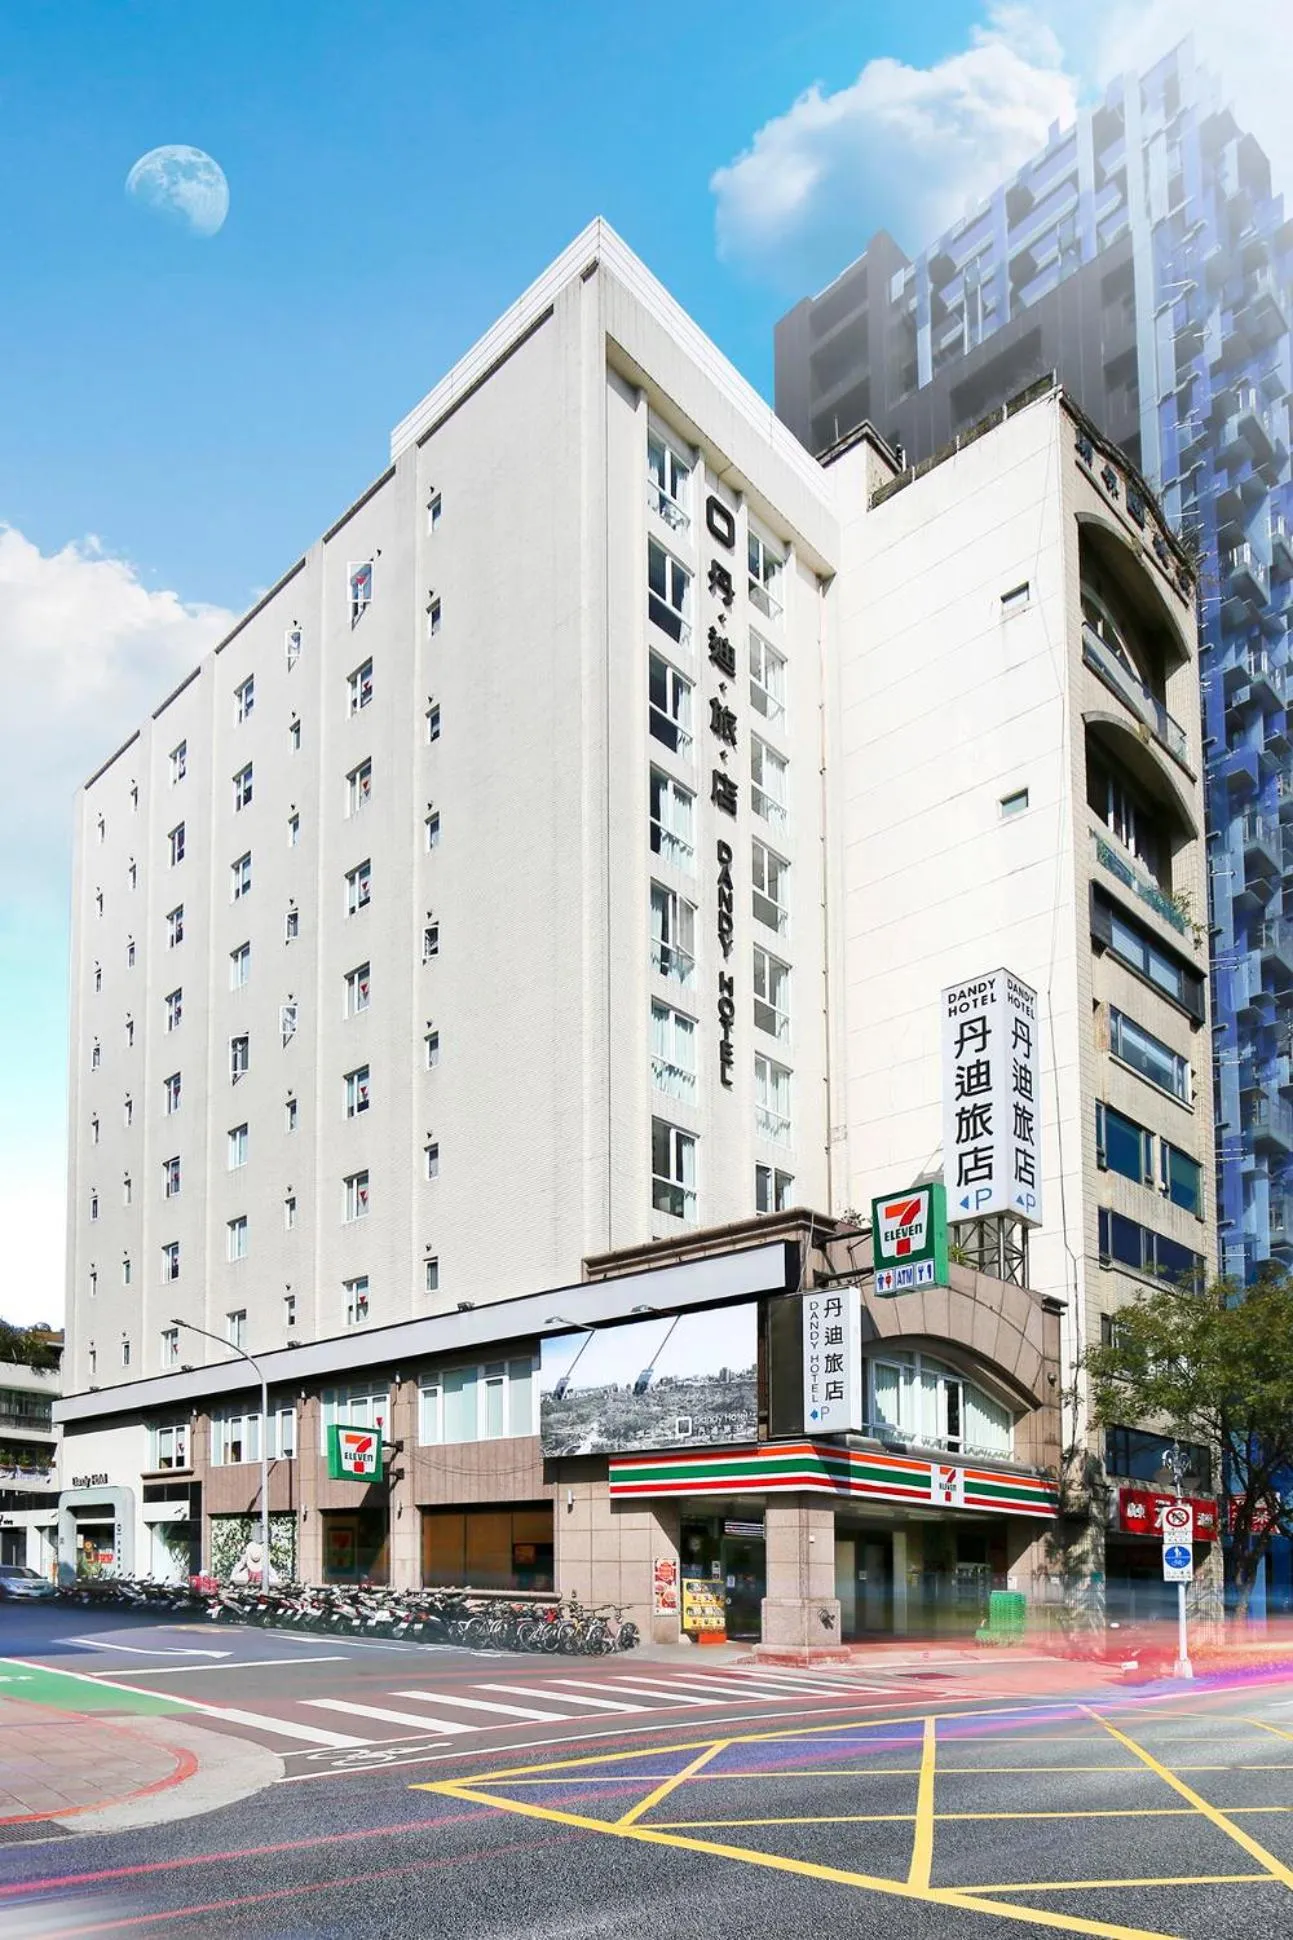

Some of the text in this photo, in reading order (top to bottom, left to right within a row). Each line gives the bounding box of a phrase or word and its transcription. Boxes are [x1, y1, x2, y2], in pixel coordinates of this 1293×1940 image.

[717, 839, 735, 1086] DANDY HOTEL
[948, 978, 996, 1005] DANDY
[948, 992, 997, 1018] HOTEL
[1007, 978, 1035, 1006] DANDY
[1007, 992, 1035, 1020] HOTEL
[954, 1015, 994, 1187] 丹迪旅店
[1011, 1016, 1035, 1189] 丹迪旅店
[976, 1188, 993, 1210] P
[1026, 1193, 1036, 1213] P
[896, 1267, 913, 1287] ATM
[809, 1301, 821, 1403] DANDY HOTEL
[823, 1297, 844, 1401] 丹迪旅店
[820, 1406, 830, 1421] P
